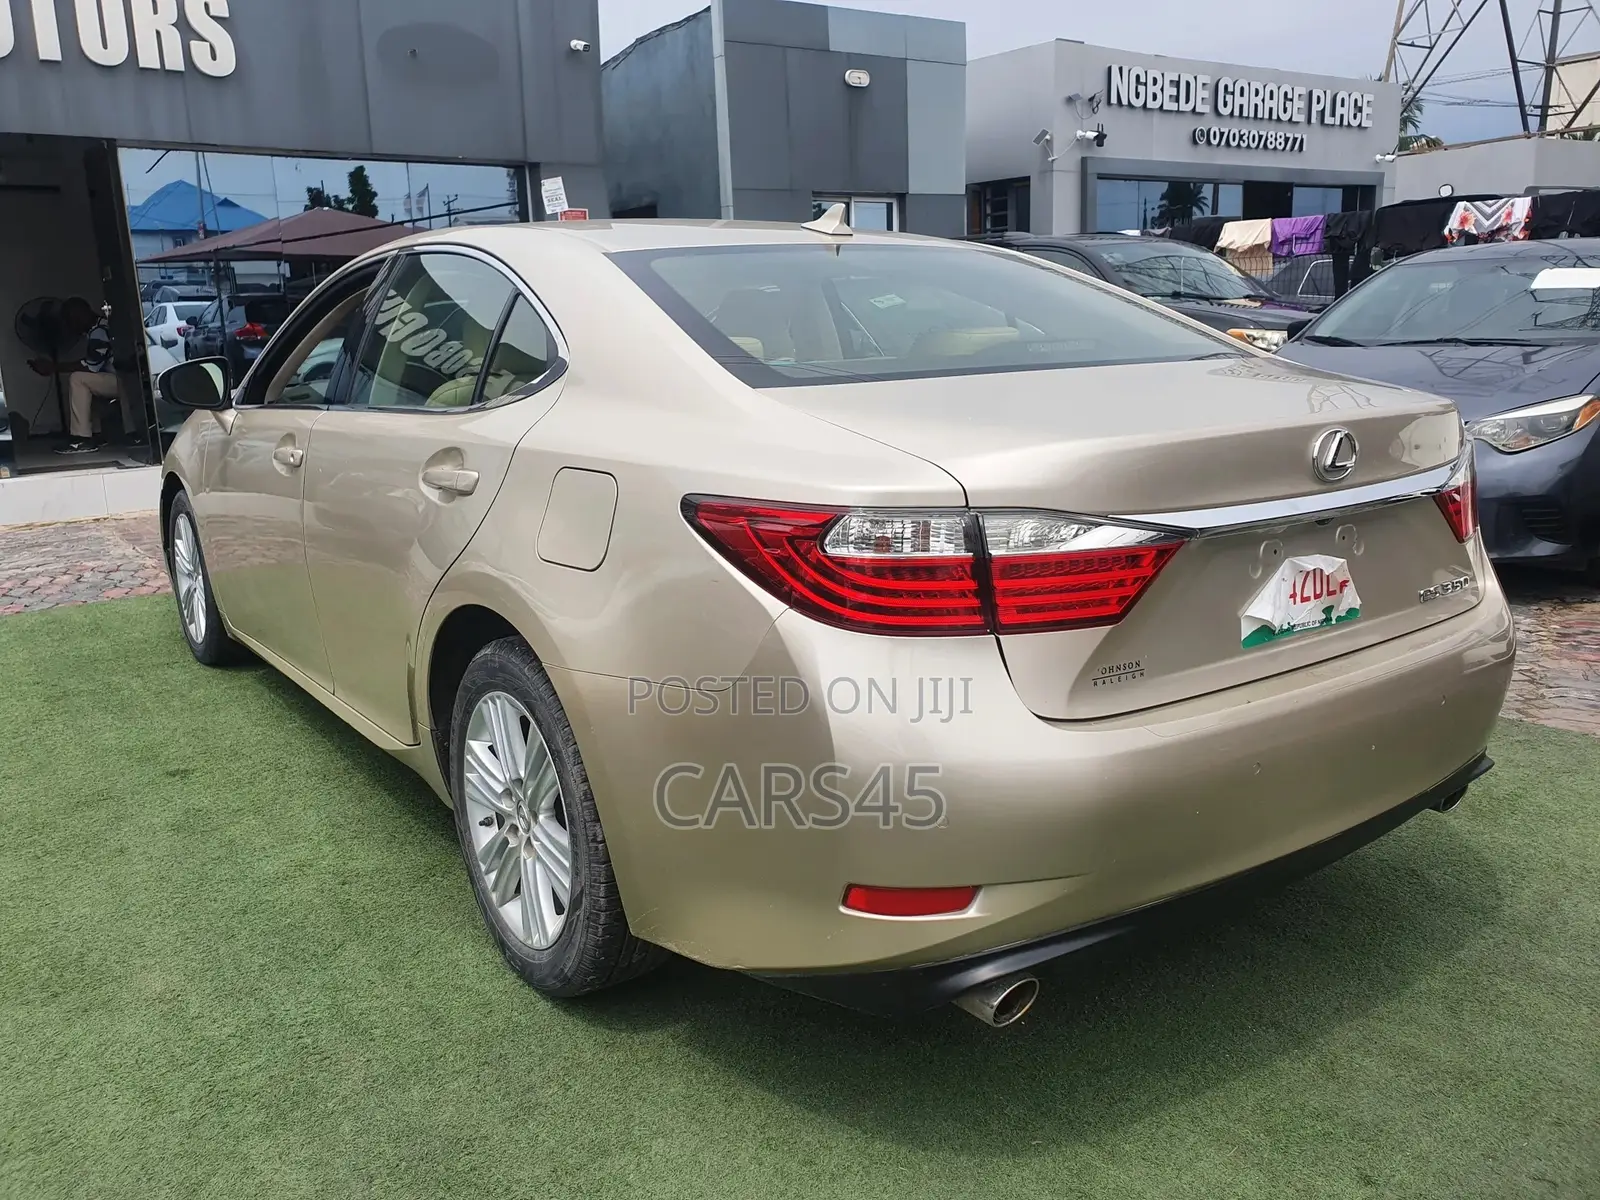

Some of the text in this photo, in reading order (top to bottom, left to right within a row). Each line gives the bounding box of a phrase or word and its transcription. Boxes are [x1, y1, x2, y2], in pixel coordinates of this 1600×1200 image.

[0, 0, 236, 77] TORS
[1108, 64, 1374, 127] NGBEDE GARAGE PLACE
[1209, 127, 1306, 152] 07030788771
[1093, 671, 1145, 687] RALEIGH
[1097, 660, 1141, 675] OHNSON
